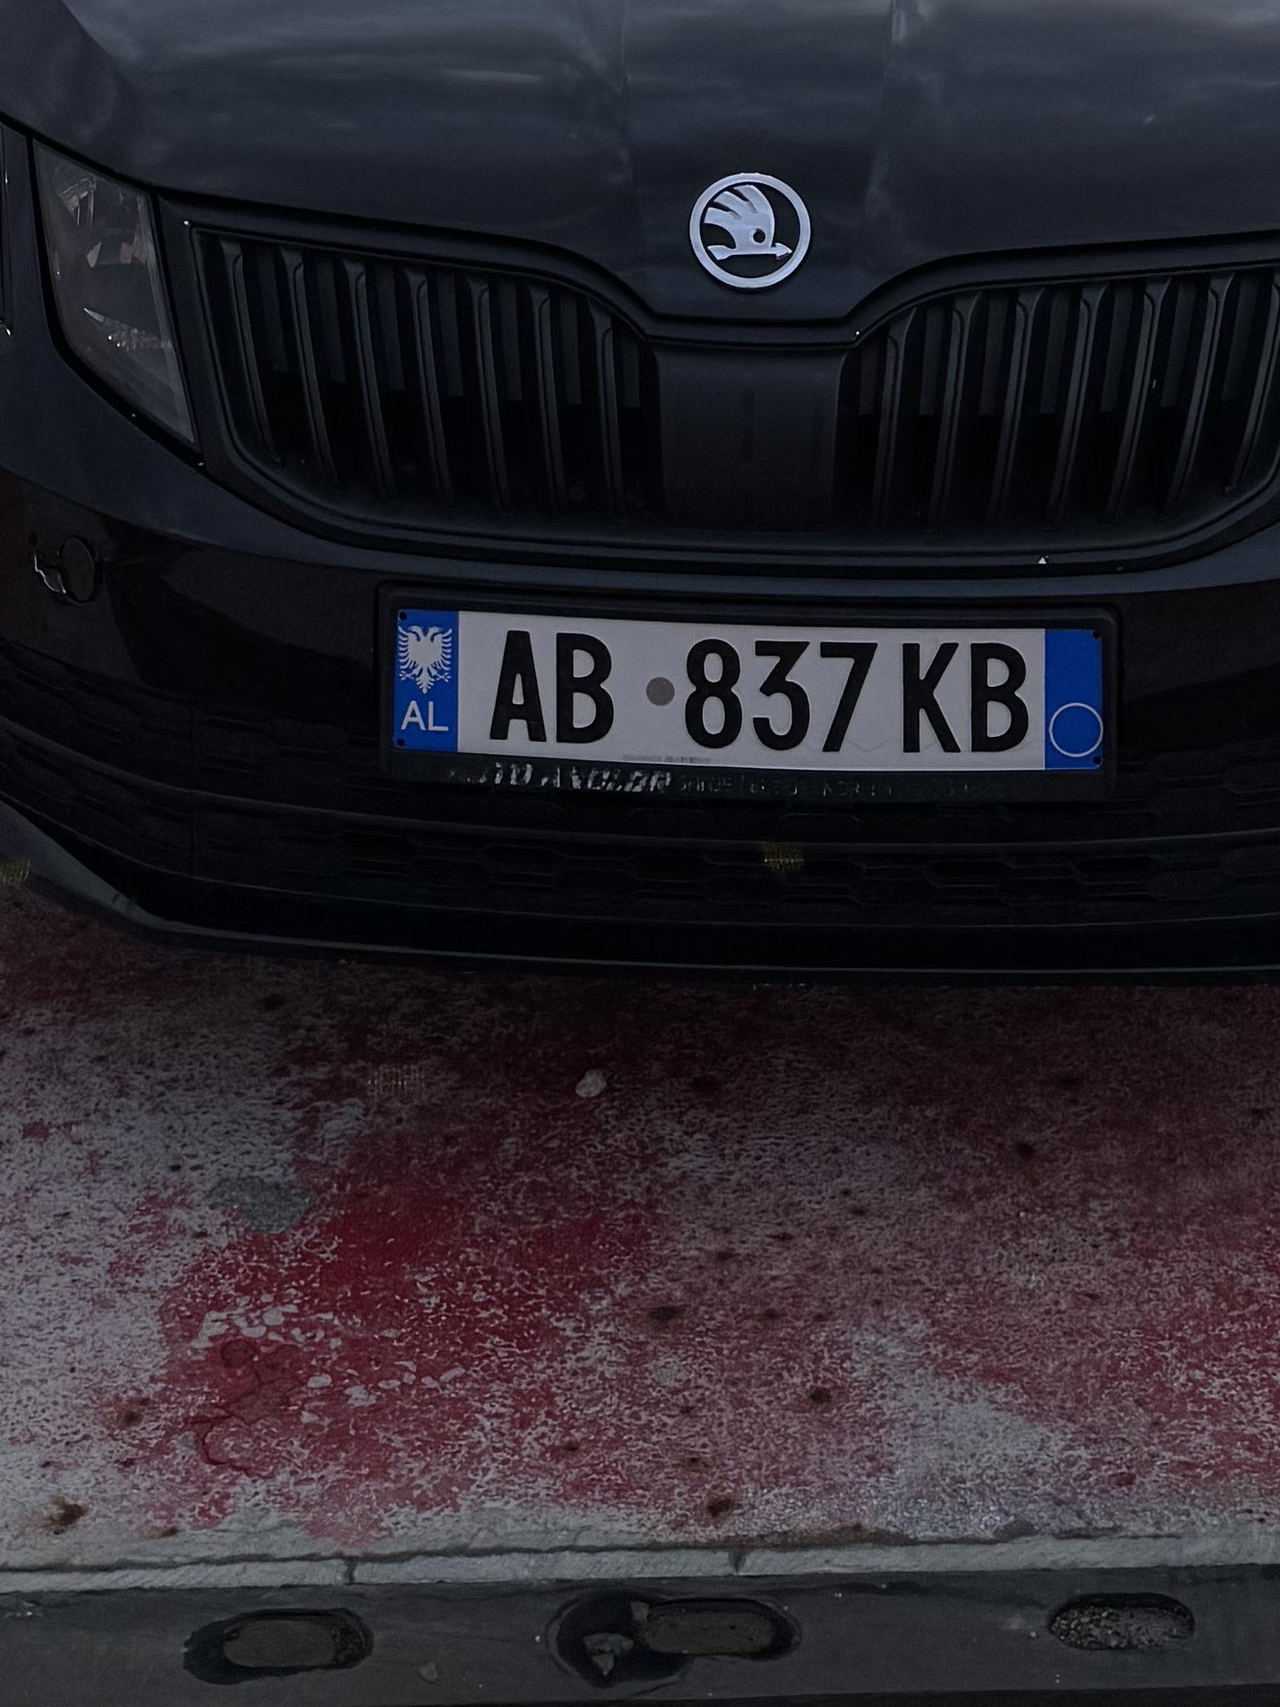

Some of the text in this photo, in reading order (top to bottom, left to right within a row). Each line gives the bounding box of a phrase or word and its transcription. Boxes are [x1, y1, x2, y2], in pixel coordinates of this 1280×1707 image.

[400, 699, 449, 731] AL
[489, 629, 1029, 753] AB 837 KB
